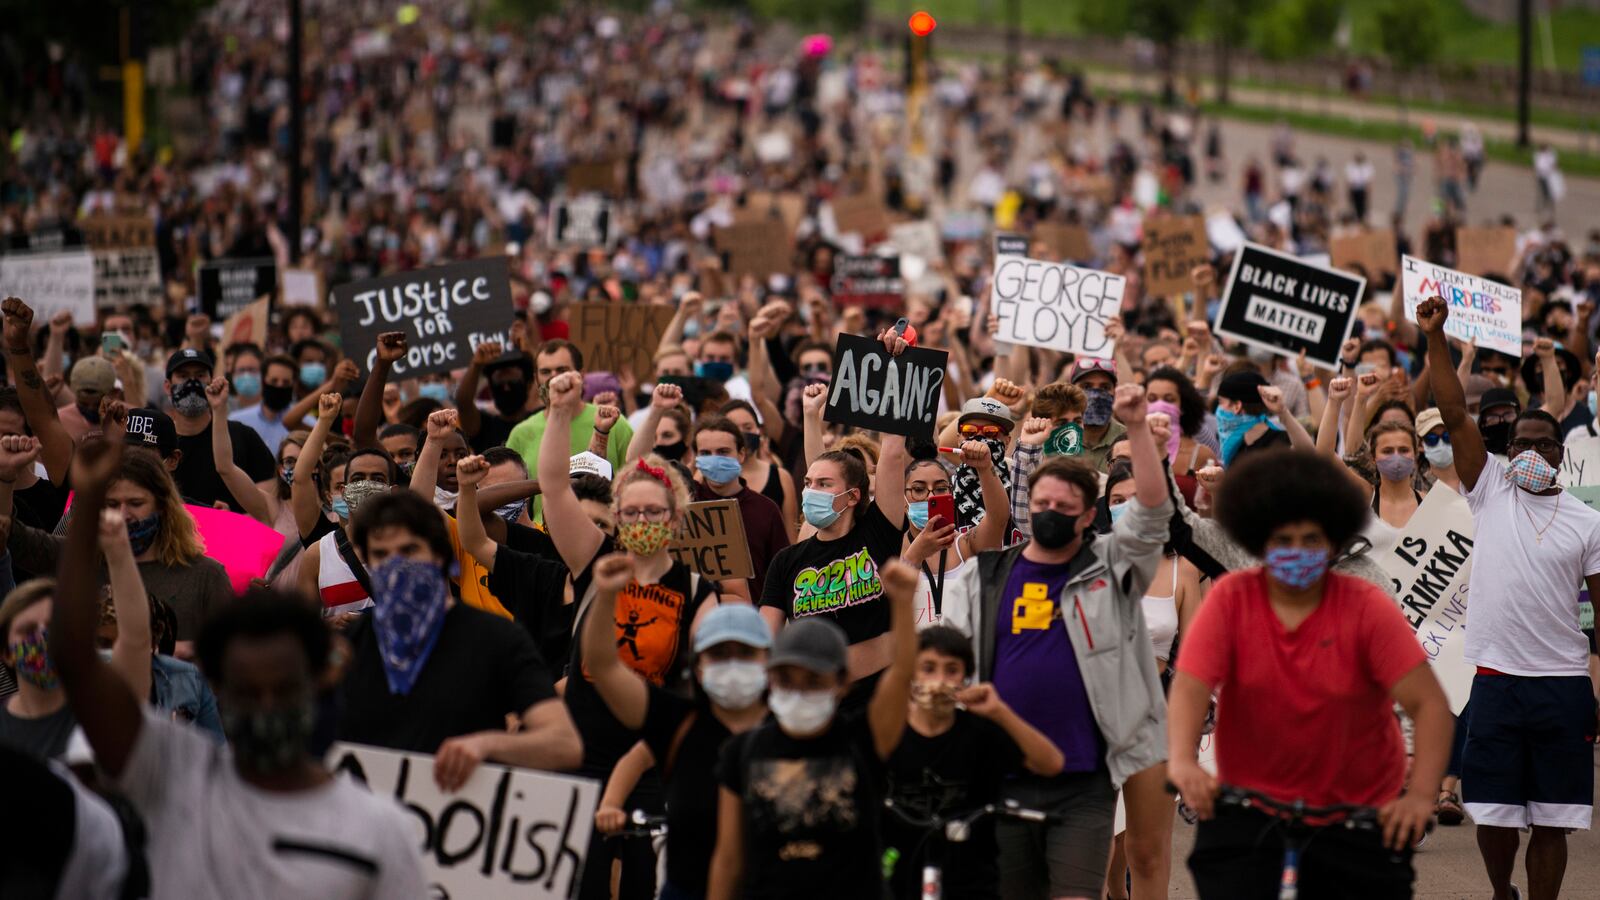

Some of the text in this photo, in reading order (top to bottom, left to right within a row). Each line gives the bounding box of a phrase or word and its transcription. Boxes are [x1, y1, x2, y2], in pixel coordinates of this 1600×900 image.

[995, 260, 1120, 318] GEORGE
[1240, 263, 1349, 313] BLACK LIVES
[1419, 276, 1501, 315] MURDERS
[580, 304, 662, 346] FUCK
[996, 299, 1109, 351] FLOYD
[1254, 303, 1317, 335] MATTER
[829, 348, 944, 423] AGAIN?
[679, 506, 729, 540] ANT
[795, 547, 874, 597] 90210
[1394, 535, 1427, 567] IS
[624, 583, 676, 608] RNING
[795, 577, 881, 613] BEVERLY HILLS
[1401, 529, 1474, 632] ERIKKKA
[1435, 583, 1470, 632] LIVES
